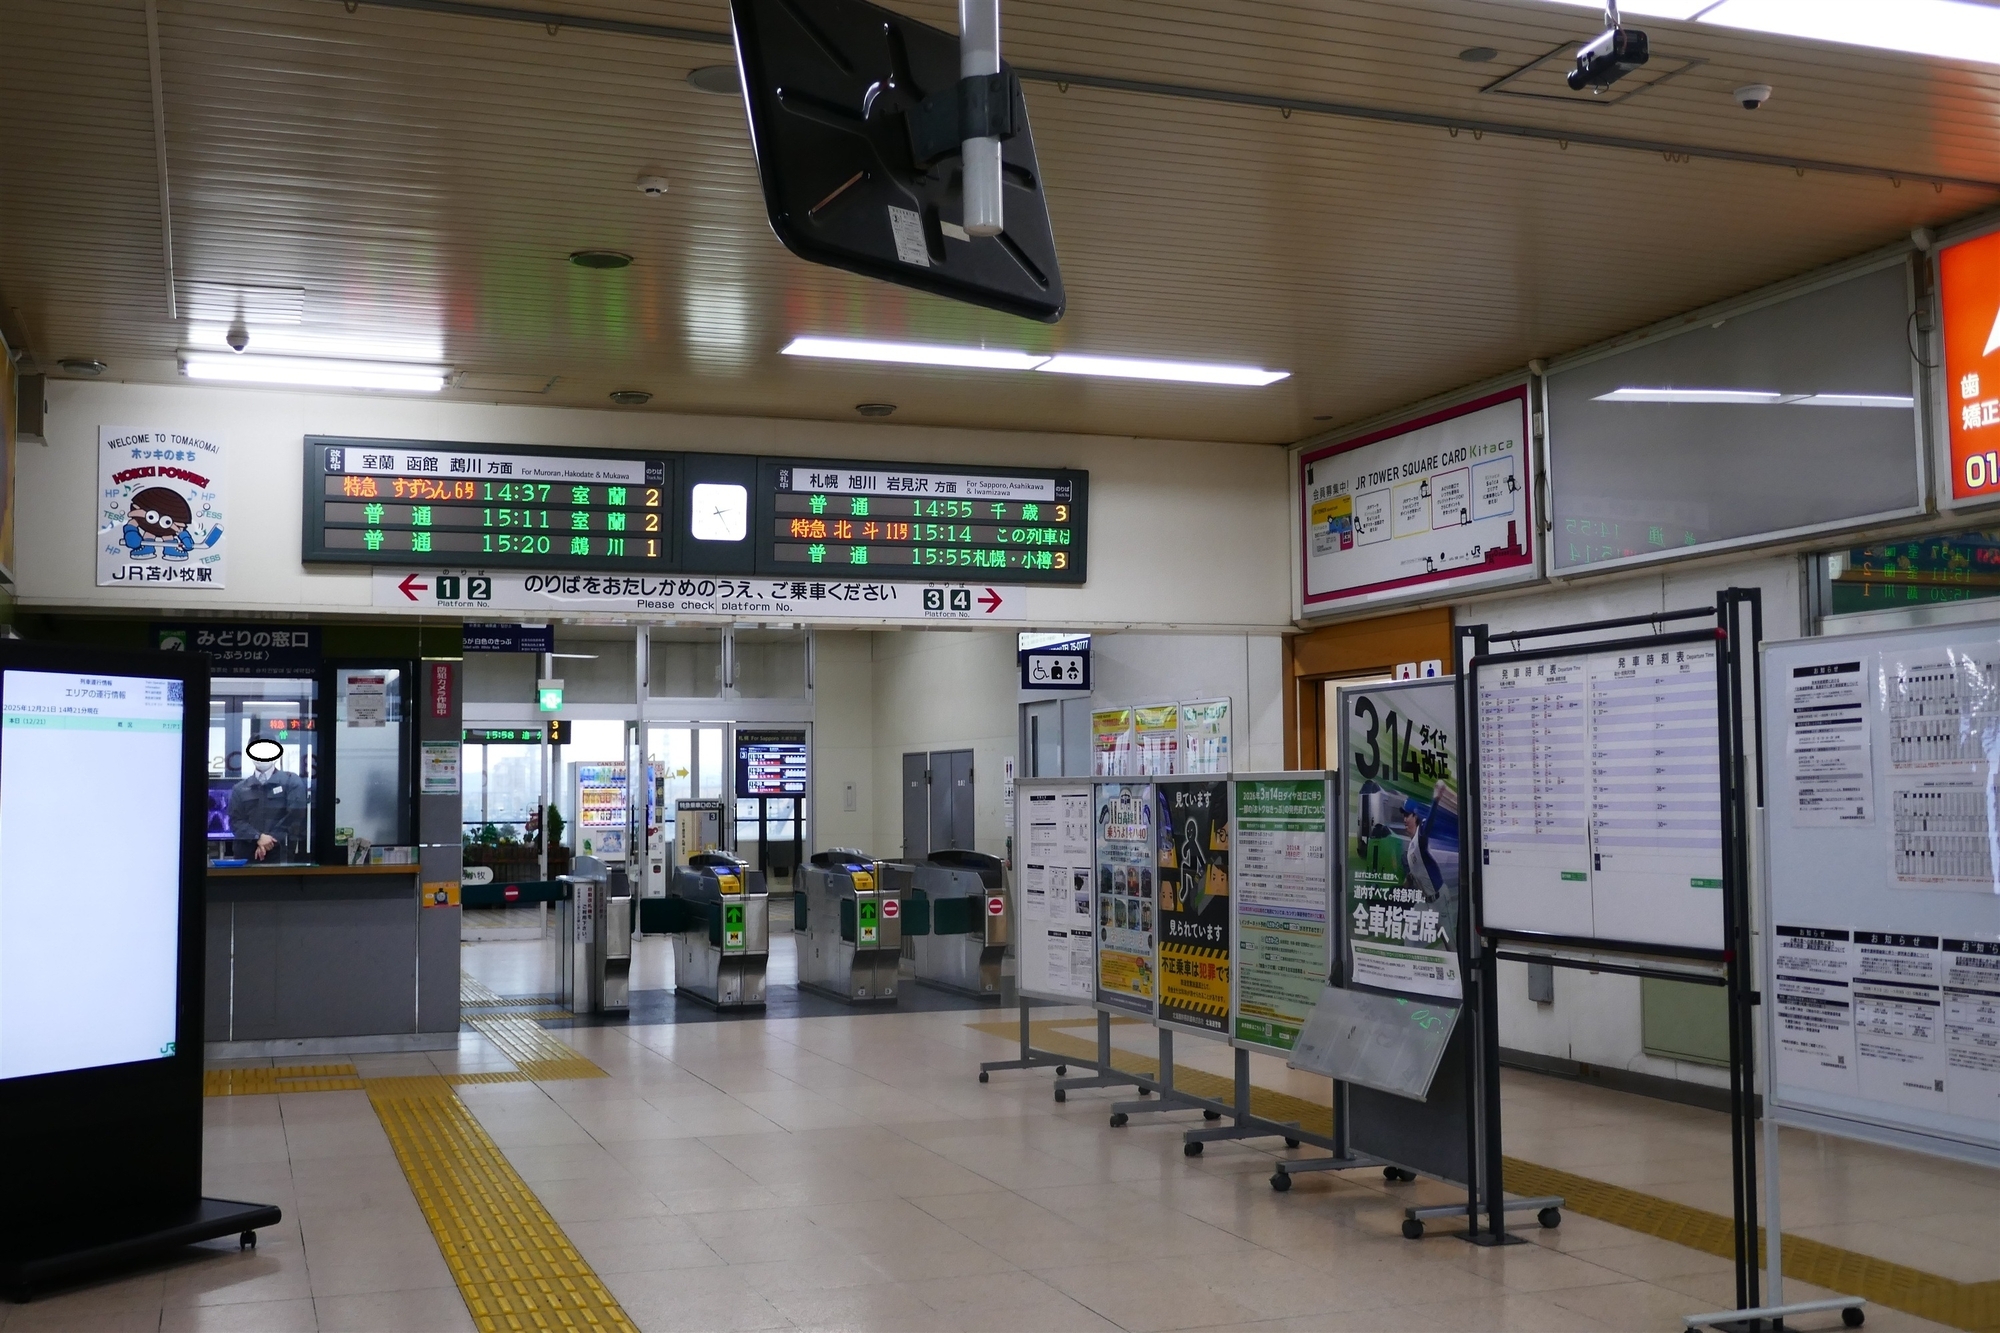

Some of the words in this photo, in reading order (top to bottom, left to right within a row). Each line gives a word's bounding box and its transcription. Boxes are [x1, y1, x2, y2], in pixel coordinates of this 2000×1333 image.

[1960, 373, 1980, 399] 歯
[1962, 399, 2000, 430] 矯正
[108, 434, 150, 449] WELCOME
[155, 434, 166, 442] TO
[171, 434, 219, 454] TOMAKOMAI
[132, 448, 195, 461] ホッキのまち
[330, 449, 340, 471] 改札中
[362, 454, 394, 471] 室蘭
[406, 456, 439, 472] 函館
[450, 457, 481, 474] 鵡川
[487, 461, 513, 475] 方面
[1355, 474, 1366, 490] JR
[1368, 467, 1400, 487] TOWER
[1403, 456, 1438, 478] SQUARE
[1442, 448, 1467, 467] CARD
[1470, 439, 1513, 458] Kitaca
[1965, 451, 2000, 488] 01
[112, 466, 156, 485] HOKKI
[779, 469, 788, 489] 改札中
[810, 474, 839, 488] 札幌
[848, 475, 877, 490] 旭川
[886, 477, 928, 492] 岩見沢
[935, 480, 957, 493] 方面
[105, 489, 120, 498] HP
[201, 492, 215, 501] HP
[344, 477, 377, 497] 特急
[483, 483, 551, 503] 14:37
[646, 488, 659, 507] 2
[104, 510, 125, 522] TESS
[202, 510, 223, 519] TESS
[483, 508, 550, 528] 15:11
[646, 513, 659, 532] 2
[913, 500, 972, 518] 14:55
[1055, 505, 1067, 522] 3
[791, 518, 826, 538] 特急
[913, 525, 972, 542] 15:14
[105, 545, 121, 556] HP
[483, 534, 550, 554] 15:20
[647, 540, 657, 557] 1
[199, 554, 221, 565] TESS
[912, 549, 971, 566] 15:55
[1055, 552, 1066, 568] 3
[112, 565, 212, 582] JR苫小牧駅
[525, 575, 897, 601] のりばをおたしかめのうえ、ご乗車ください
[637, 600, 675, 609] Please
[681, 600, 714, 610] check
[722, 602, 770, 612] platform
[776, 603, 793, 612] No.
[197, 630, 309, 647] みどりの窓口
[1618, 651, 1685, 669] 発車時刻表
[65, 689, 126, 700] エリアの運行情報
[3, 704, 57, 713] 2025年12月21日
[552, 721, 559, 729] 3
[486, 731, 514, 740] 15:58
[551, 731, 559, 740] 4
[1355, 696, 1421, 782] 3.14
[1419, 724, 1447, 750] ダイヤ
[1421, 749, 1449, 780] 改正
[1175, 791, 1211, 808] 見ています
[1118, 812, 1134, 824] 日高線
[1169, 919, 1223, 942] 見られています
[1353, 903, 1449, 943] 全車指定席へ
[1800, 929, 1825, 937] お知らせ
[1871, 934, 1920, 947] お知らせ
[1962, 941, 2000, 954] お知ら
[160, 1042, 176, 1054] JR
